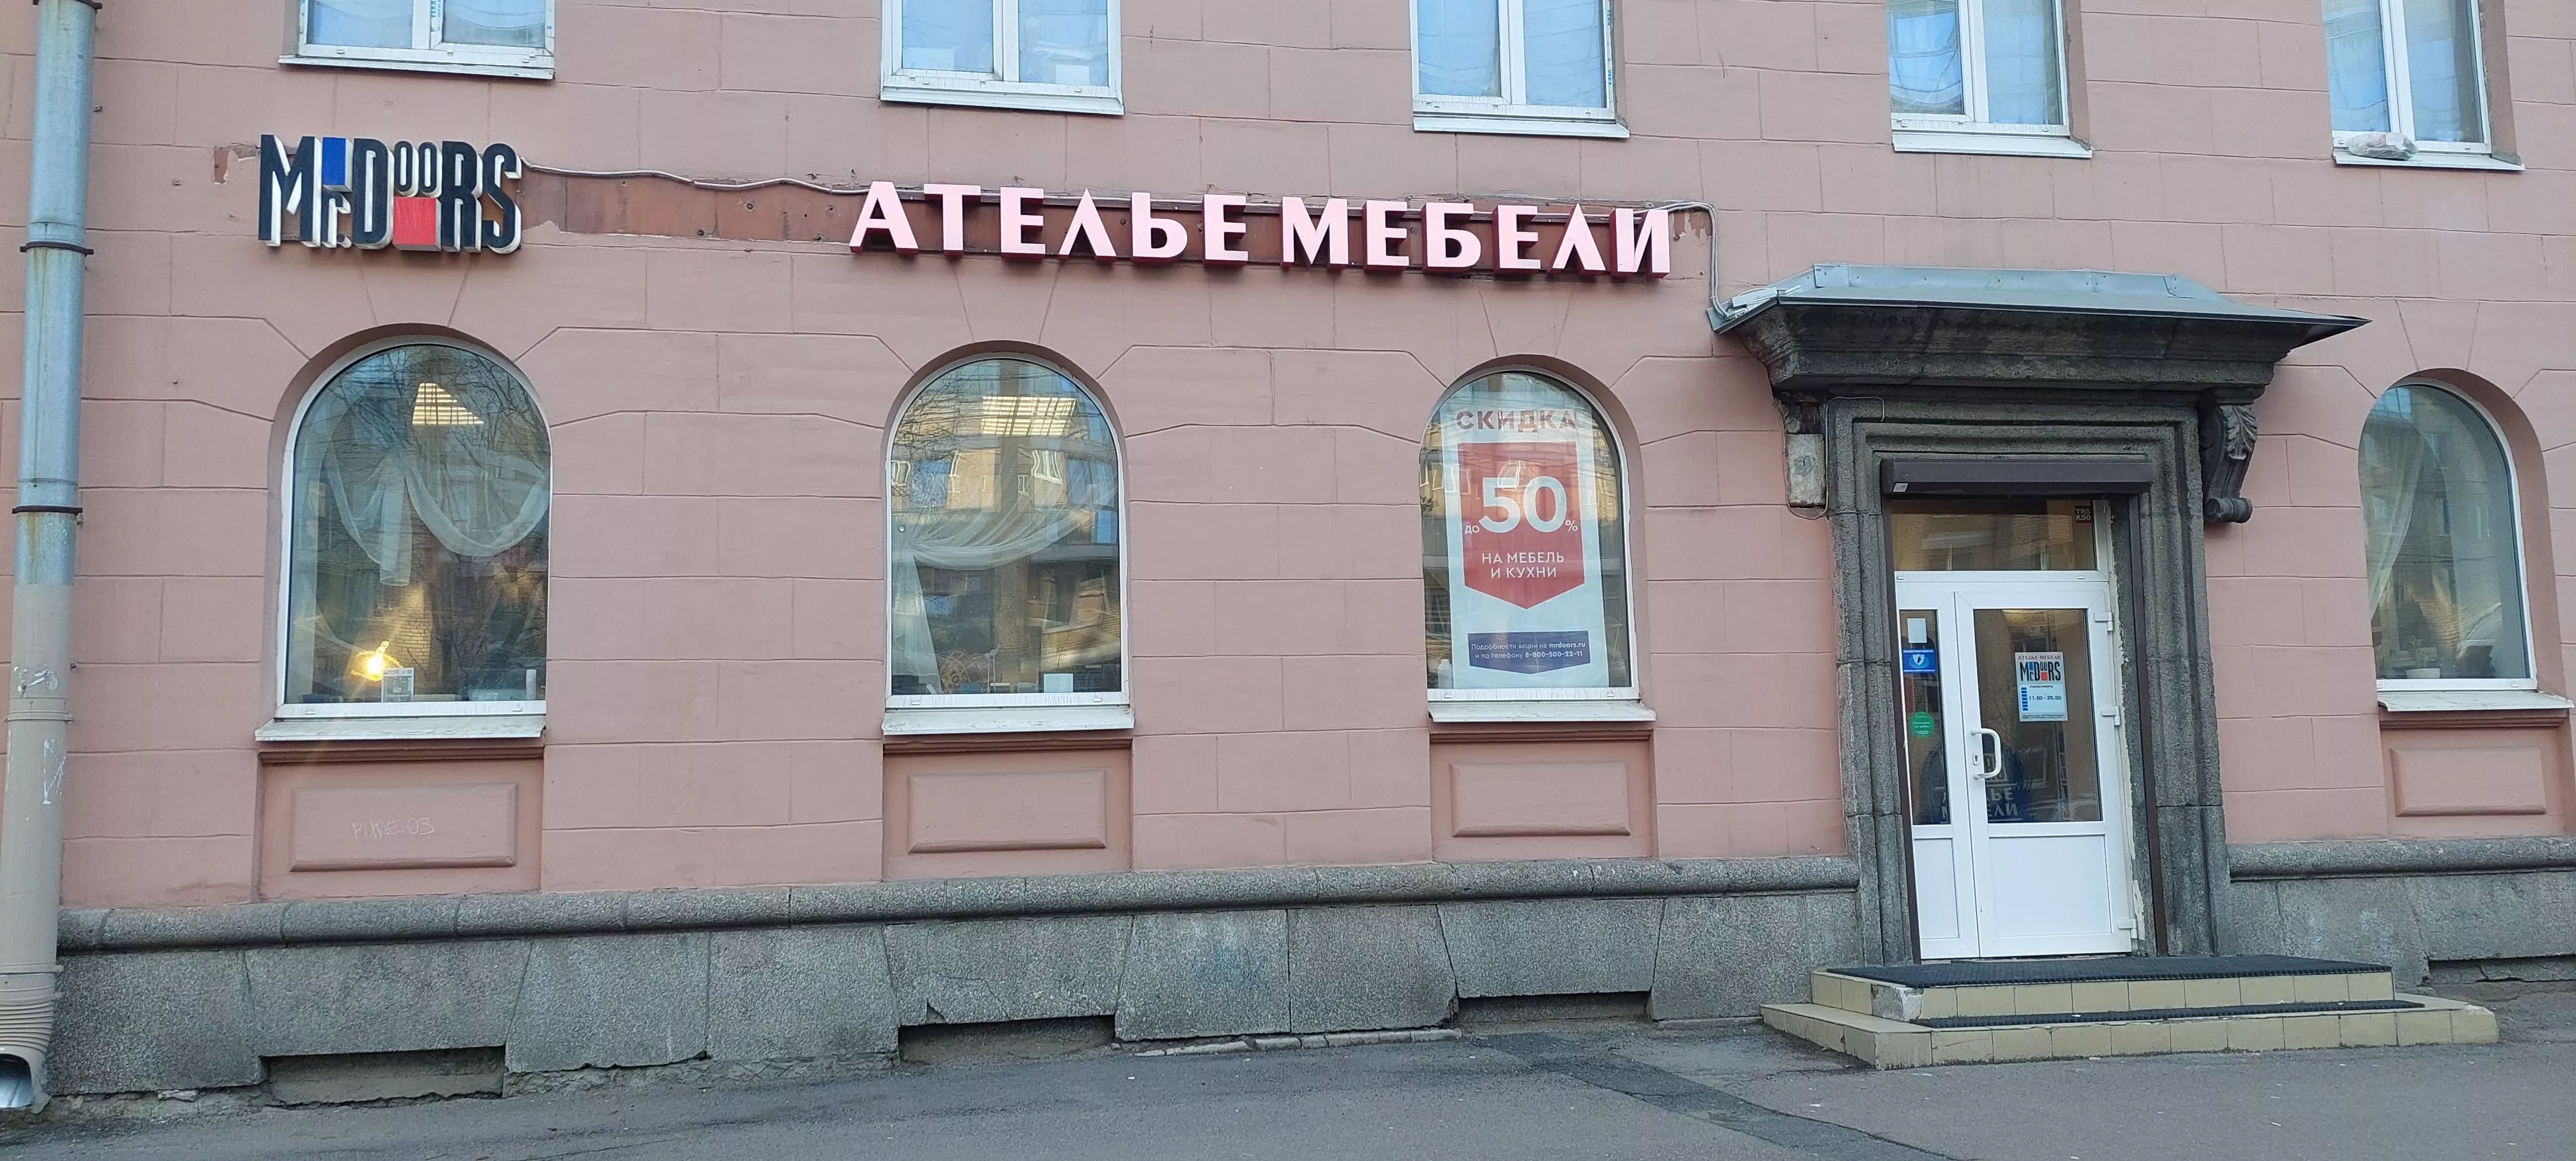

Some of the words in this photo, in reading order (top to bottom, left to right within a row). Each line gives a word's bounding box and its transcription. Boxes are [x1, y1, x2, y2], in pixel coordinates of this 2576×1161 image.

[848, 181, 1249, 266] АТЕЛЬЕ
[1281, 196, 1671, 279] МЕБЕЛИ
[1456, 410, 1577, 432] СКИДКА
[1479, 475, 1568, 533] 50
[1565, 520, 1578, 531] %
[1482, 553, 1502, 564] НА
[1507, 552, 1564, 564] МЕБЕЛЬ
[1491, 567, 1501, 578] И
[1506, 567, 1557, 578] КУХНИ
